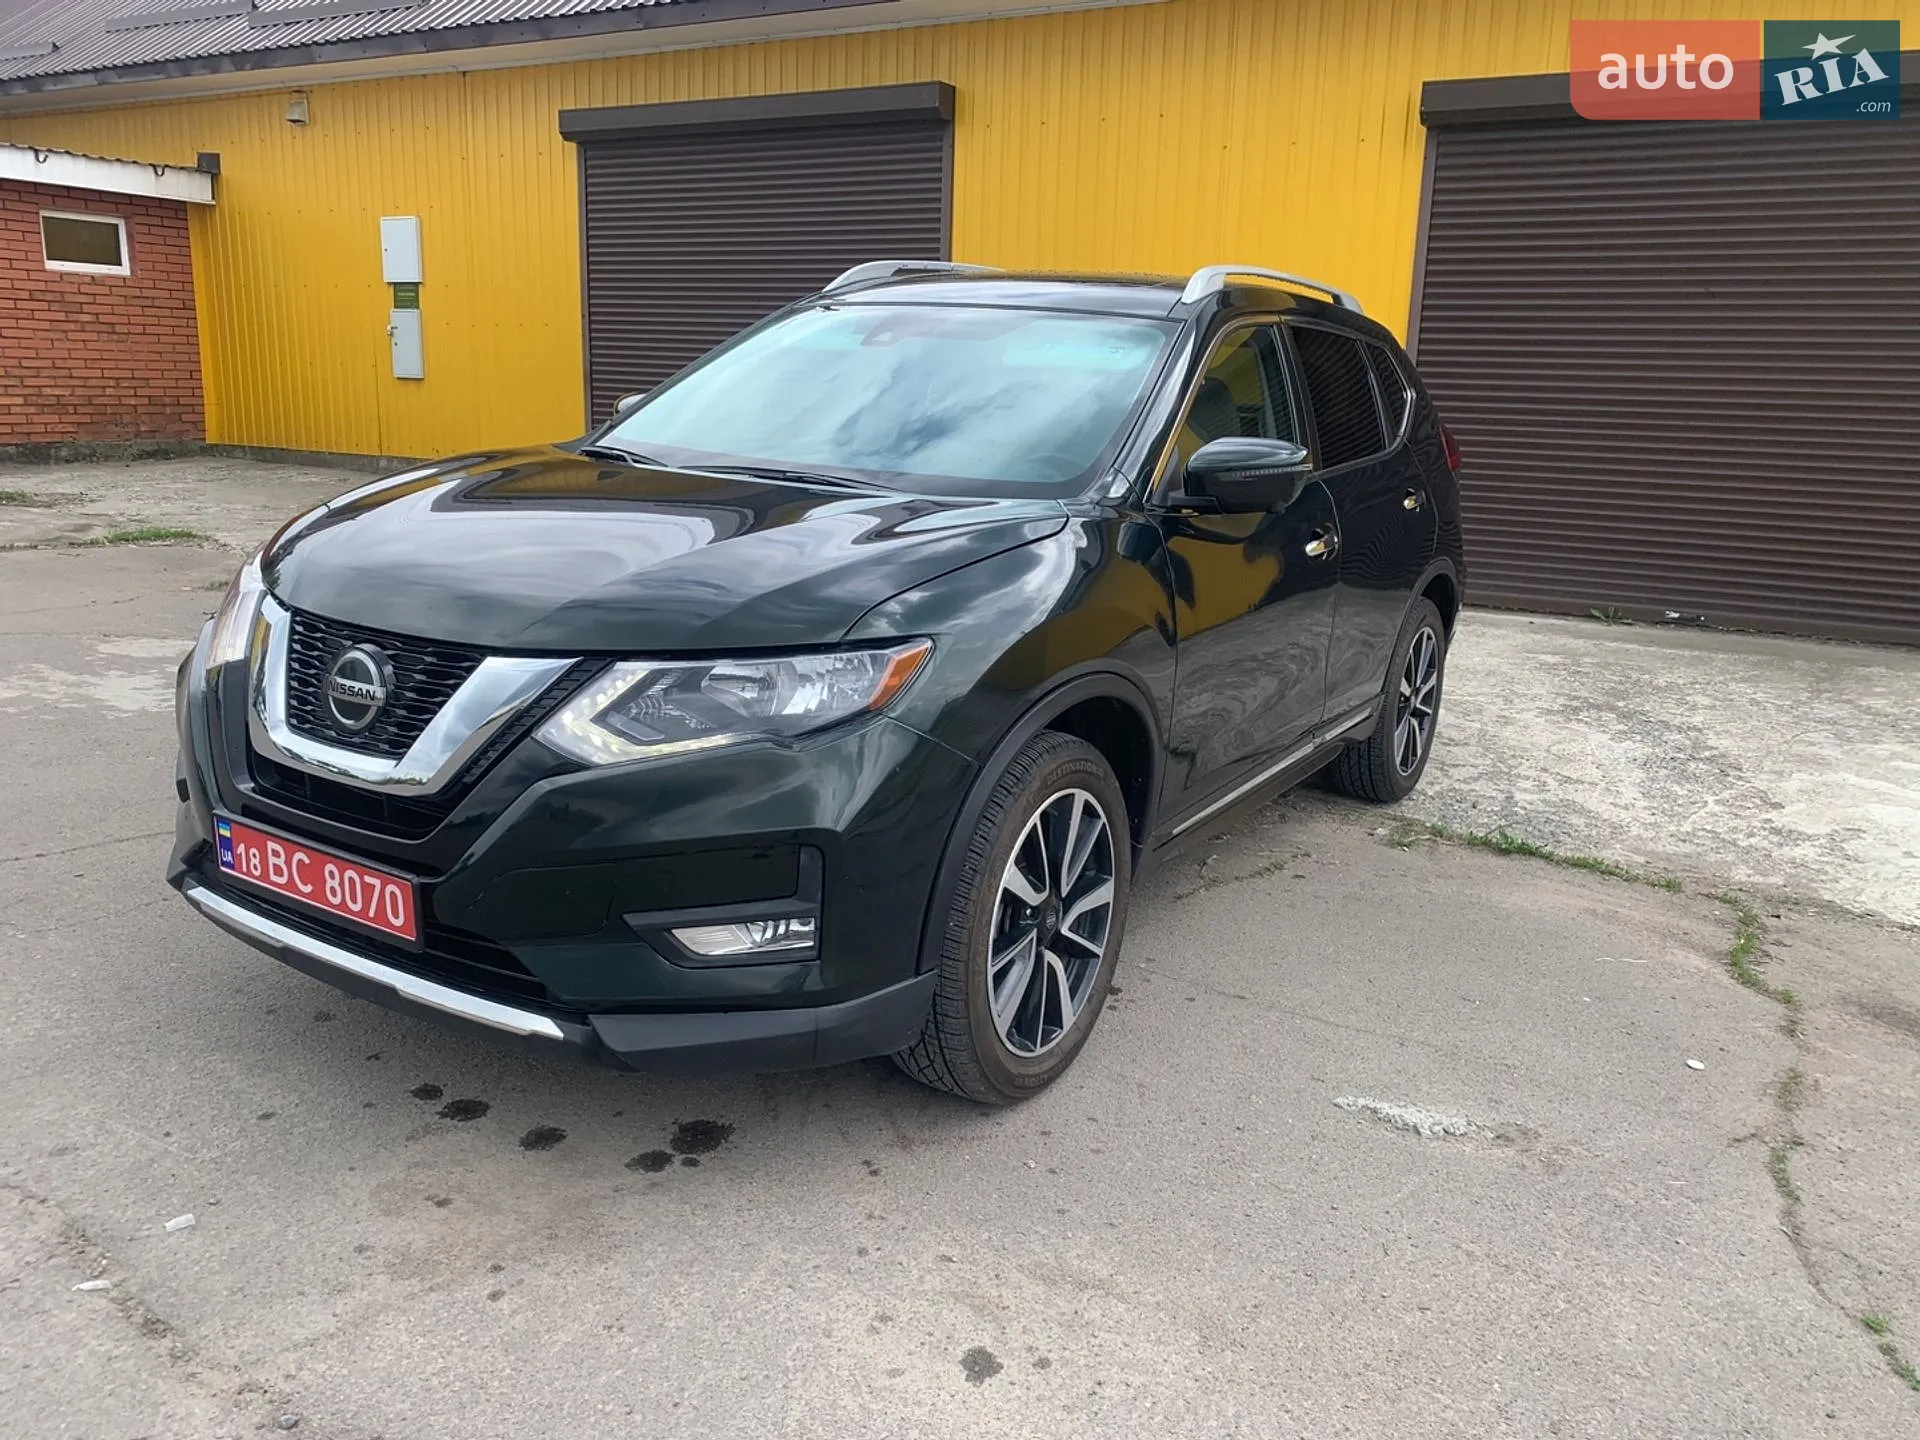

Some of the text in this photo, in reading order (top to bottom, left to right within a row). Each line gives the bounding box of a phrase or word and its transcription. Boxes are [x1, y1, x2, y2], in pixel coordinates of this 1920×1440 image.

[329, 680, 376, 701] NISSAN
[221, 848, 234, 864] UA
[236, 840, 405, 927] 18 BC 8070
